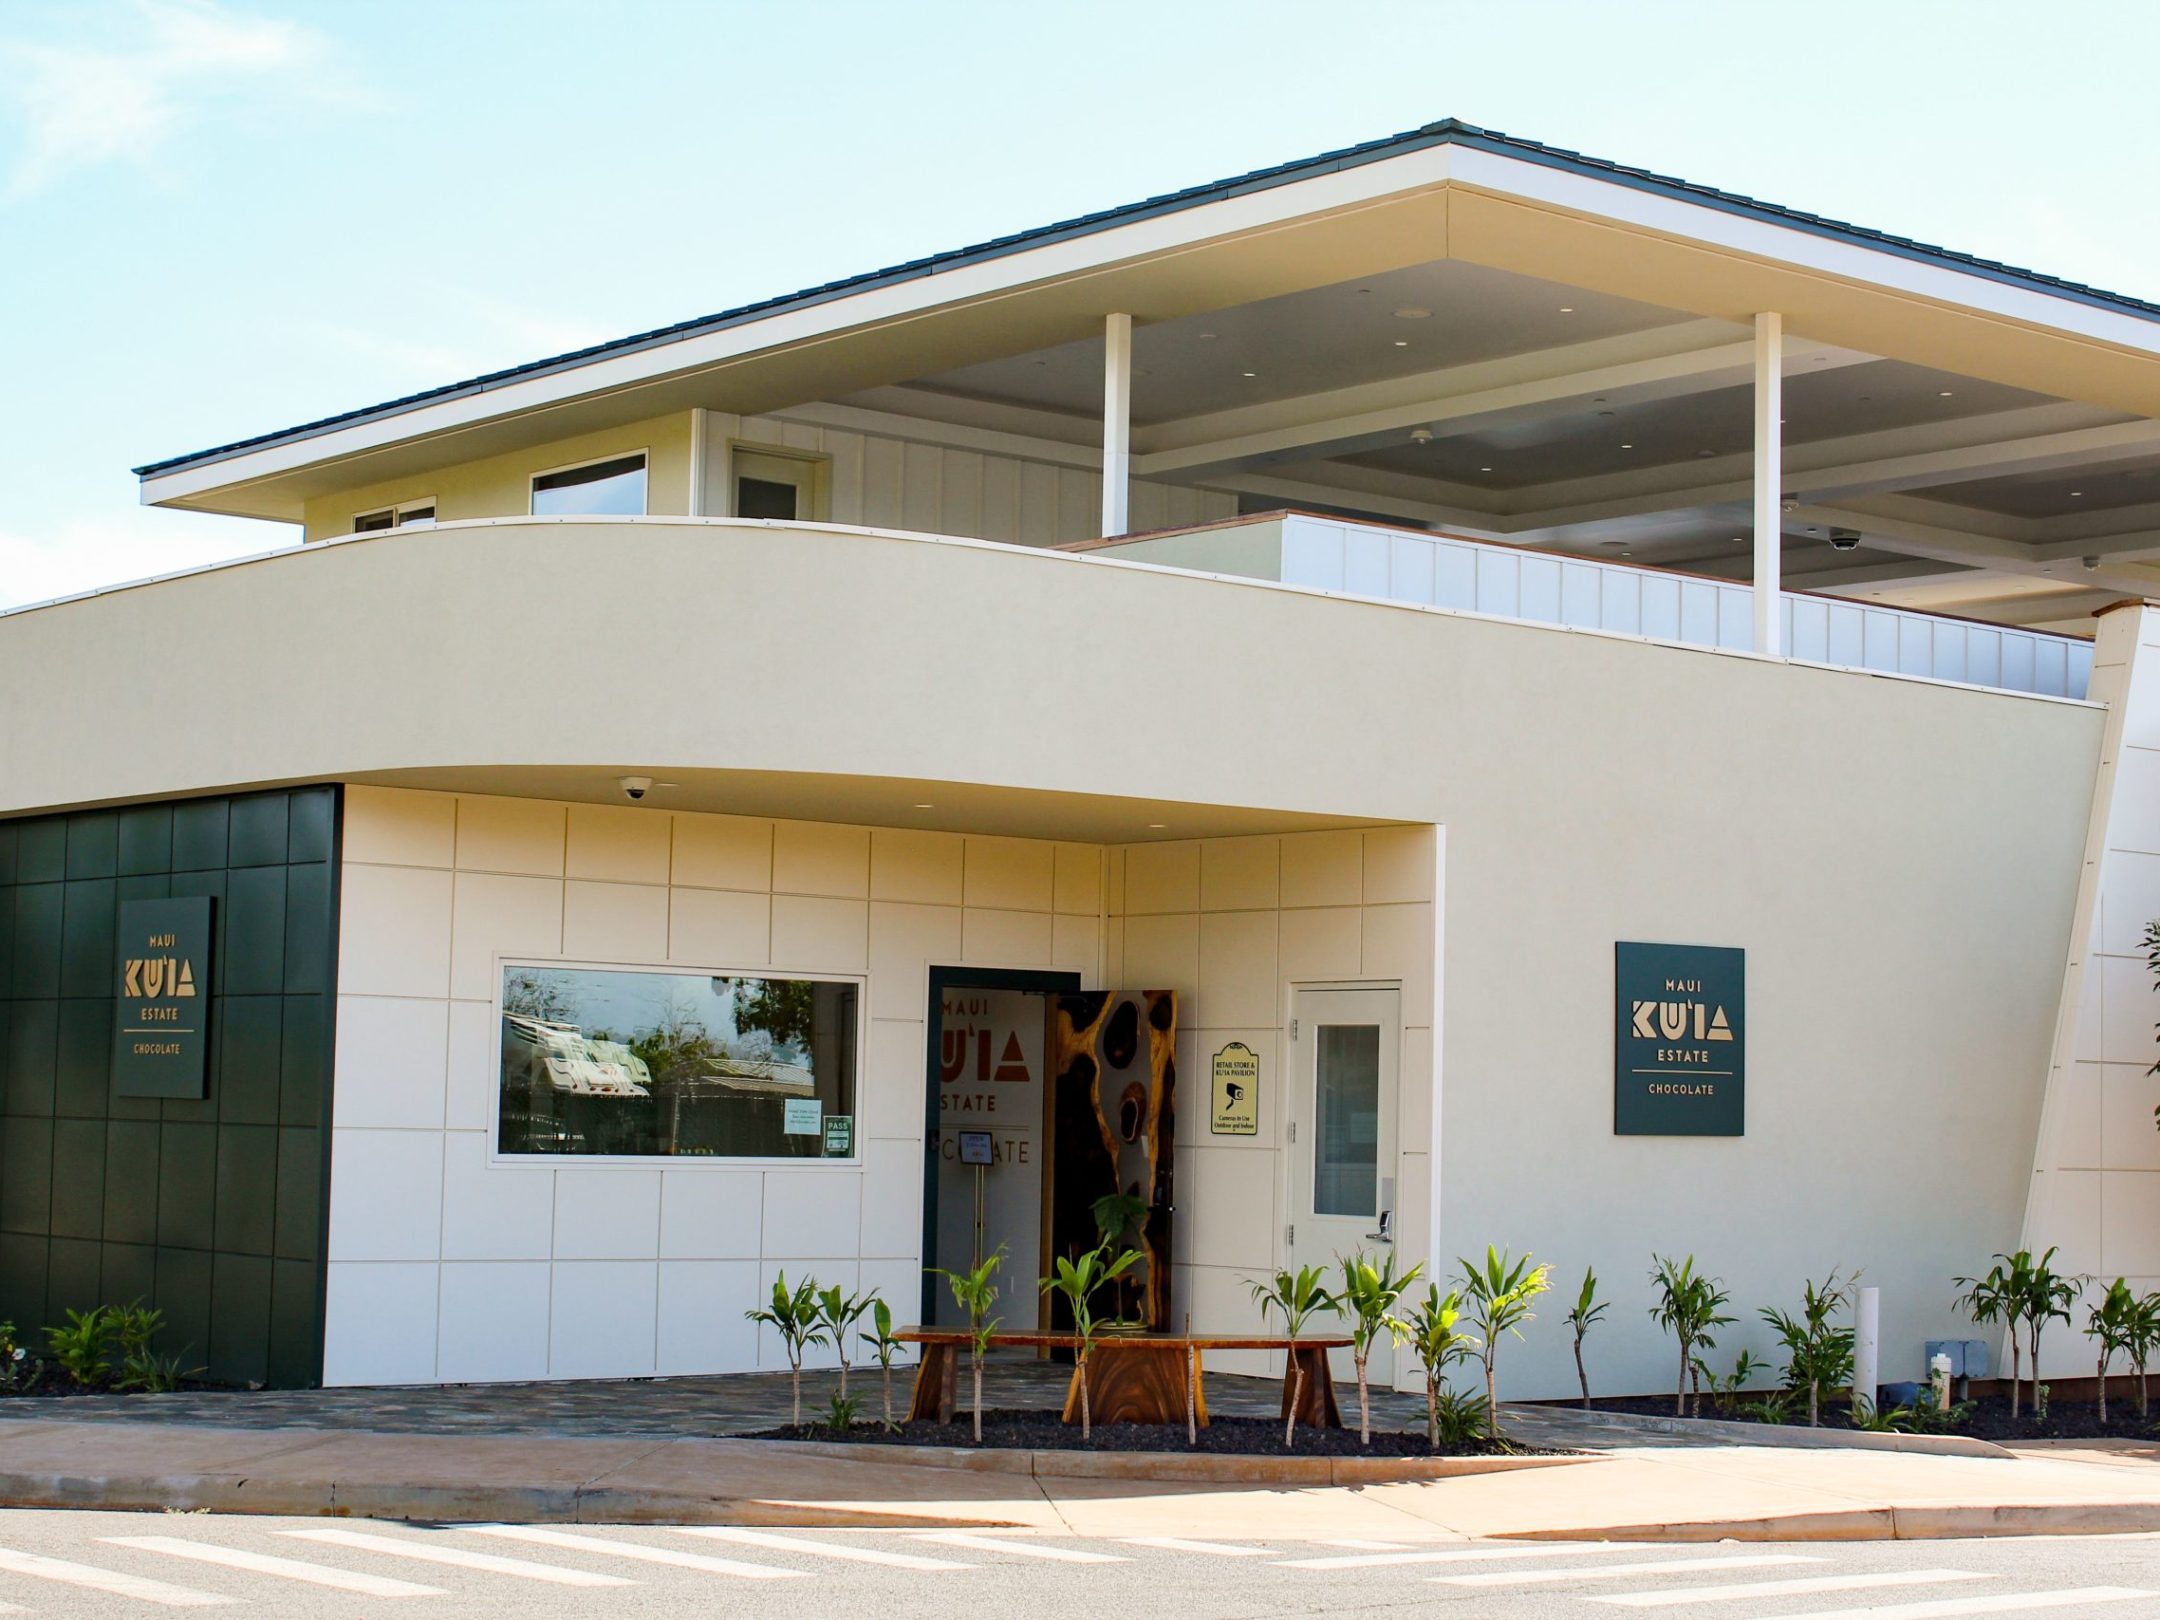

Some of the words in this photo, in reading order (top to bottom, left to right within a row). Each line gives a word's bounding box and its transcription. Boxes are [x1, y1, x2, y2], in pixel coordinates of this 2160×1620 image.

[149, 934, 175, 947] MAUI
[1665, 979, 1701, 992] MAUI
[141, 1008, 178, 1020] ESTATE
[133, 1043, 180, 1054] CHOCOLATE
[940, 1022, 1030, 1082] U'IA
[1657, 1049, 1709, 1063] ESTATE
[1648, 1083, 1714, 1095] CHOCOLATE
[940, 1094, 996, 1111] STATE
[828, 1122, 848, 1130] PASS
